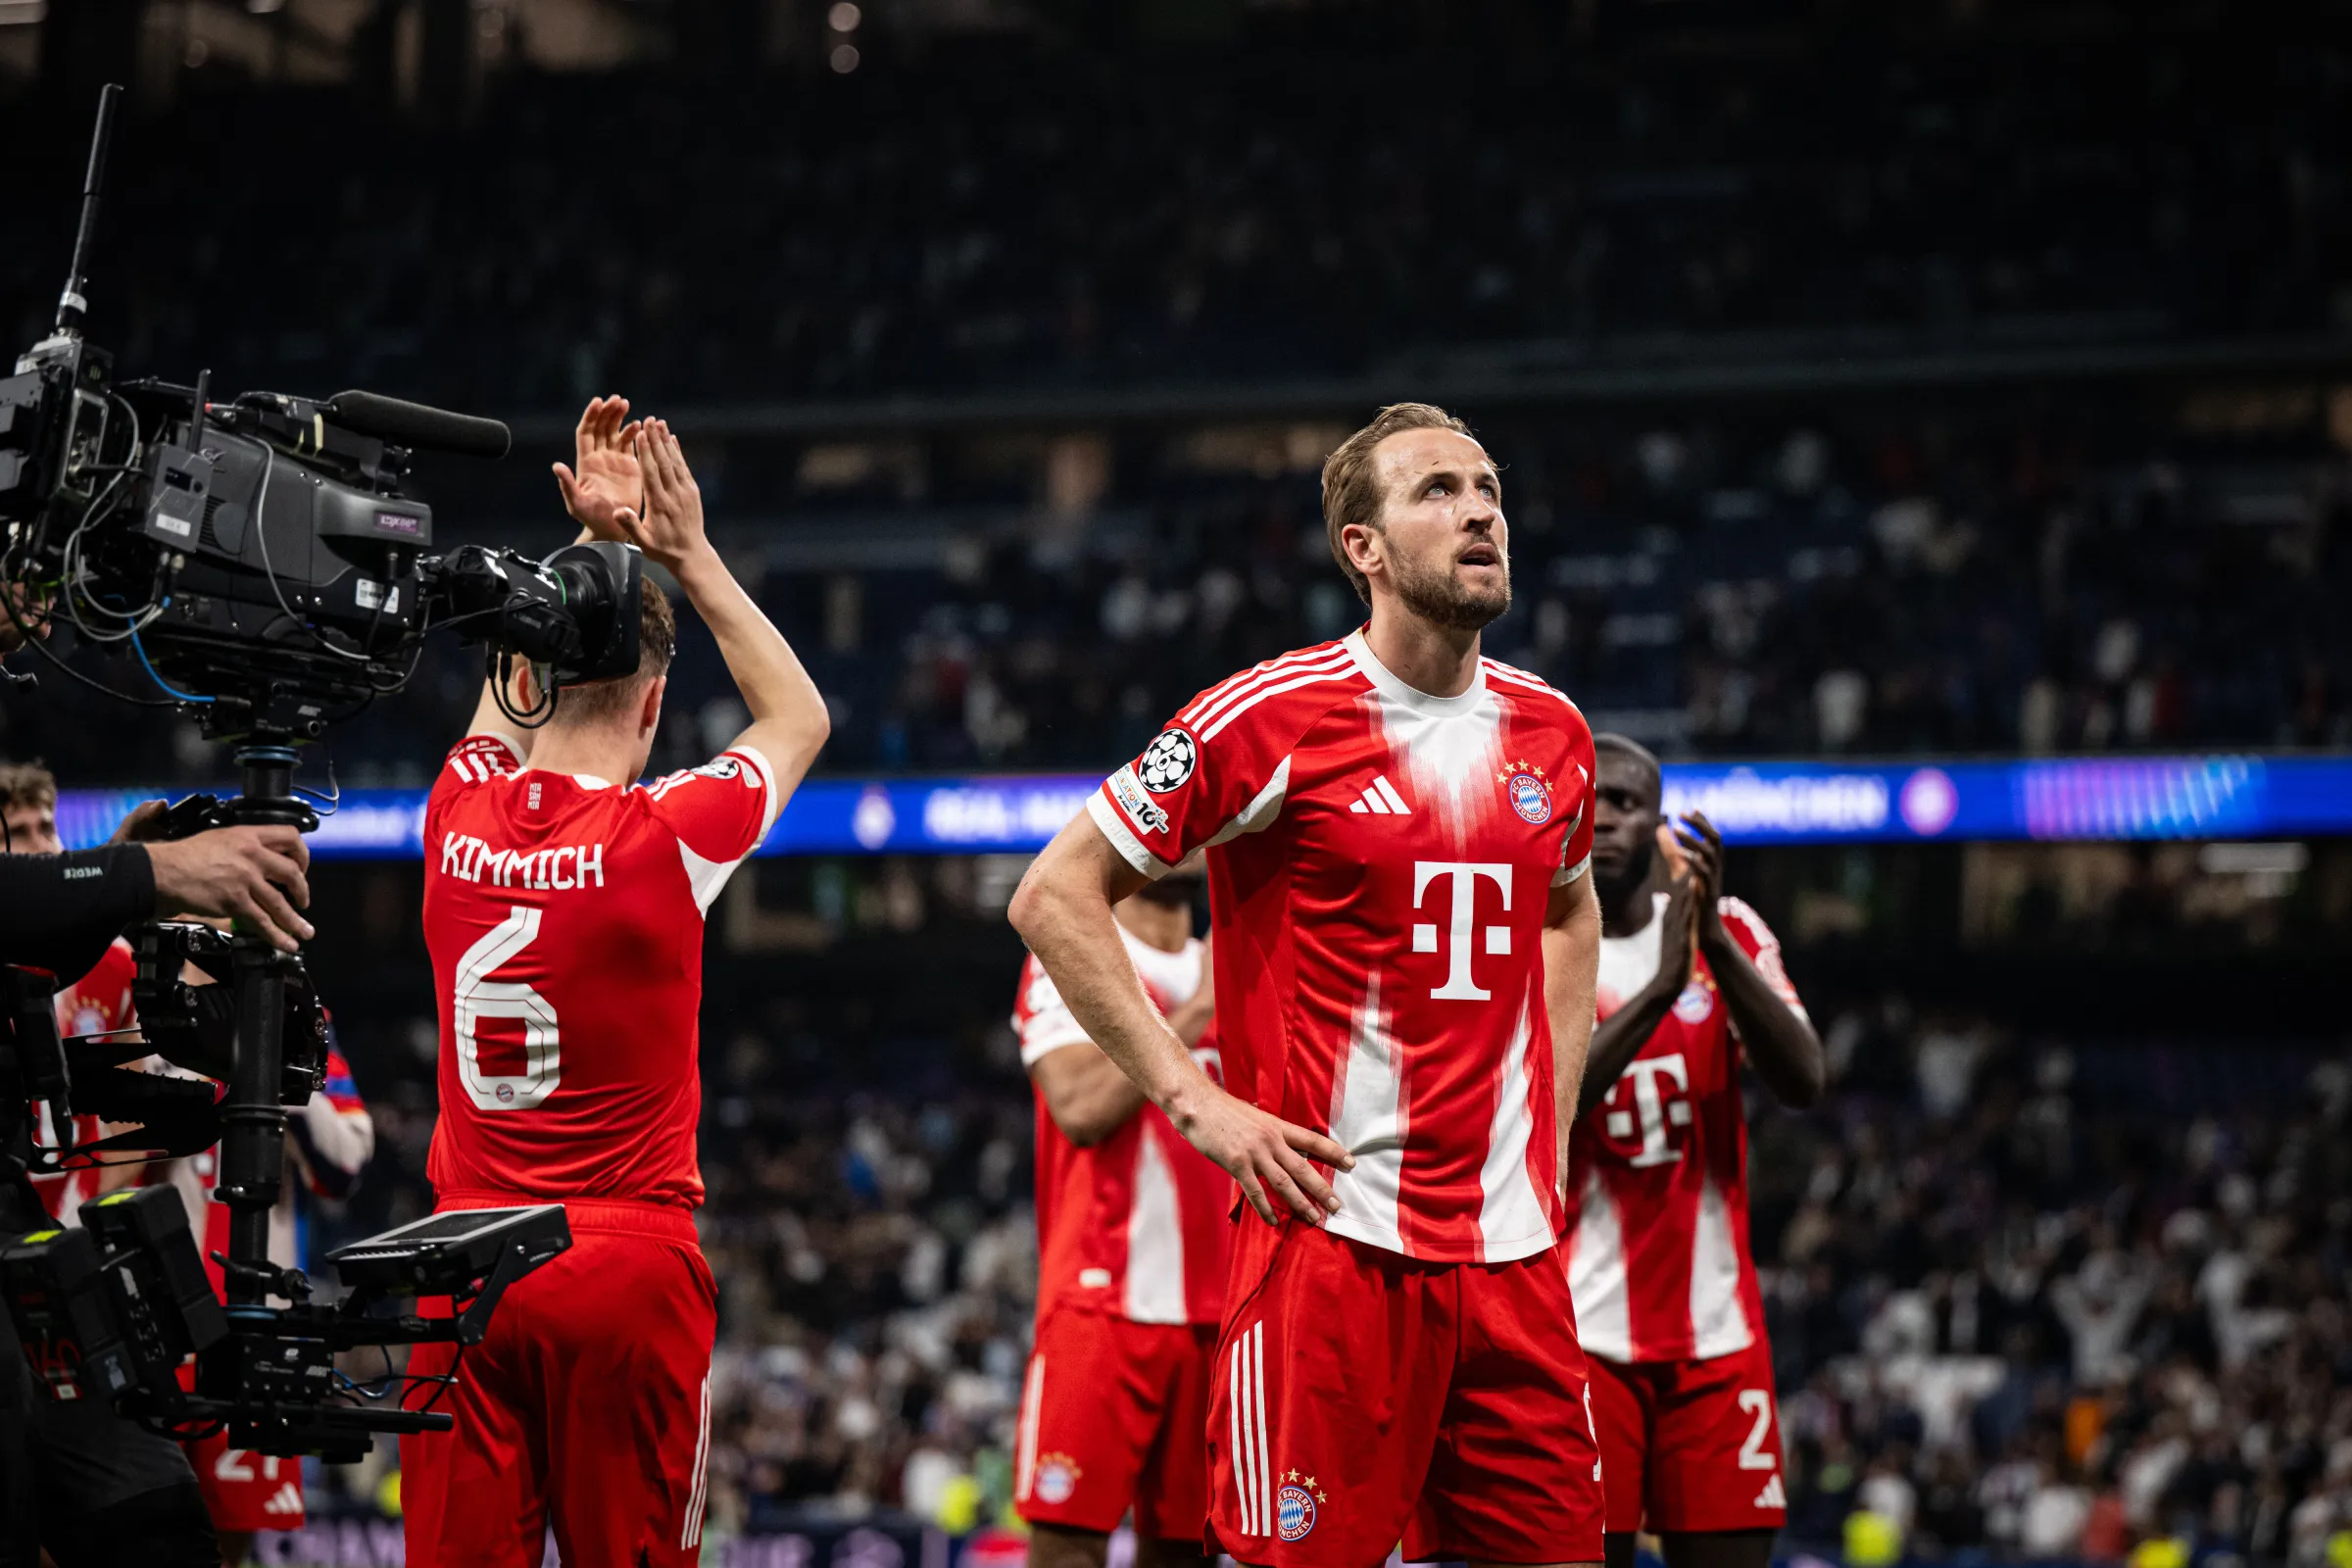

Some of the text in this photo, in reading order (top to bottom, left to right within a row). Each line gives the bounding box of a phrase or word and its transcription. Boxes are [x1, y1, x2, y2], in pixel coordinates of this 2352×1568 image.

[1155, 748, 1176, 771] 6
[1512, 778, 1545, 799] FC BAYERN
[1137, 802, 1156, 826] 10
[441, 831, 605, 890] KIMMICH
[1412, 860, 1512, 1001] T
[454, 906, 562, 1111] 6
[1604, 1053, 1691, 1168] T
[1739, 1389, 1776, 1470] 2
[1282, 1490, 1312, 1513] BAYERN
[1278, 1520, 1310, 1539] NCHEN
